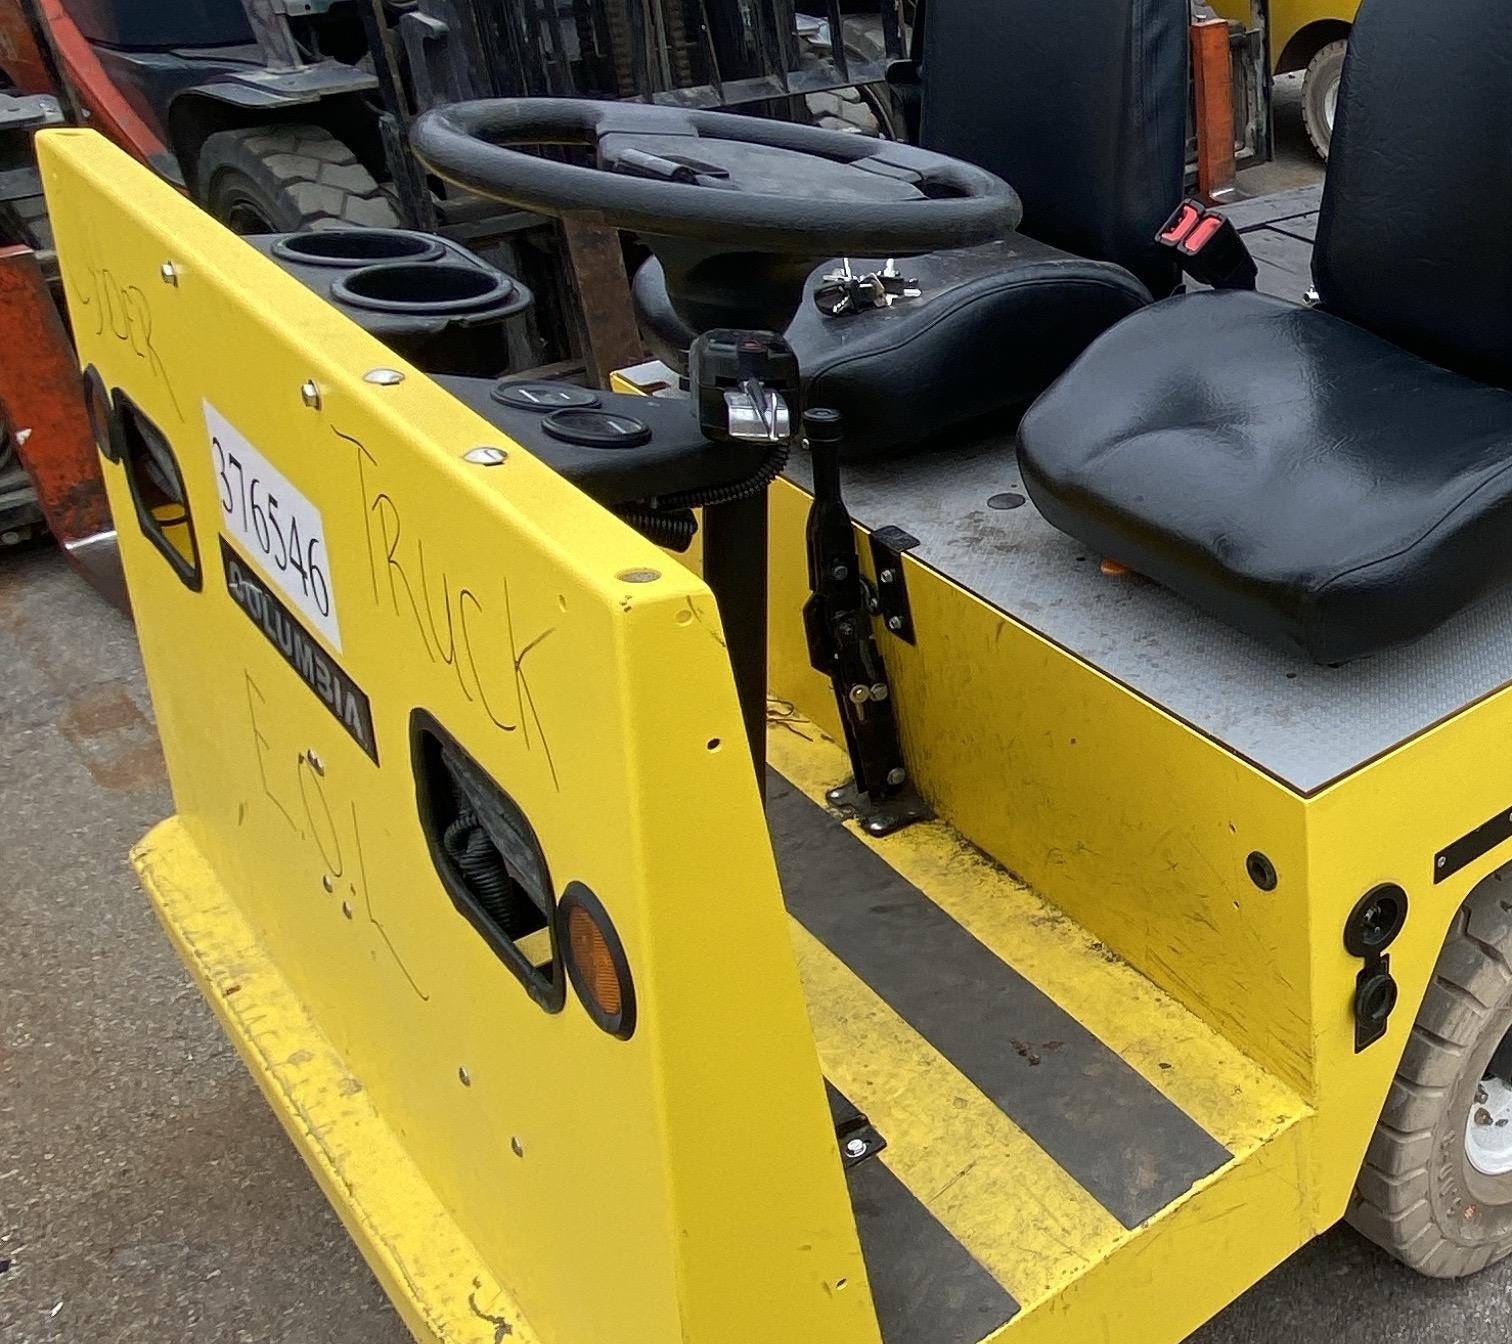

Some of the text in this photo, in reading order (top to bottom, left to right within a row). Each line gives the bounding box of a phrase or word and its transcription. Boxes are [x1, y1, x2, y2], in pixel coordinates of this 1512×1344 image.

[212, 435, 330, 619] 376546
[330, 423, 556, 793] TRUCK
[228, 559, 372, 759] COLUMBIA
